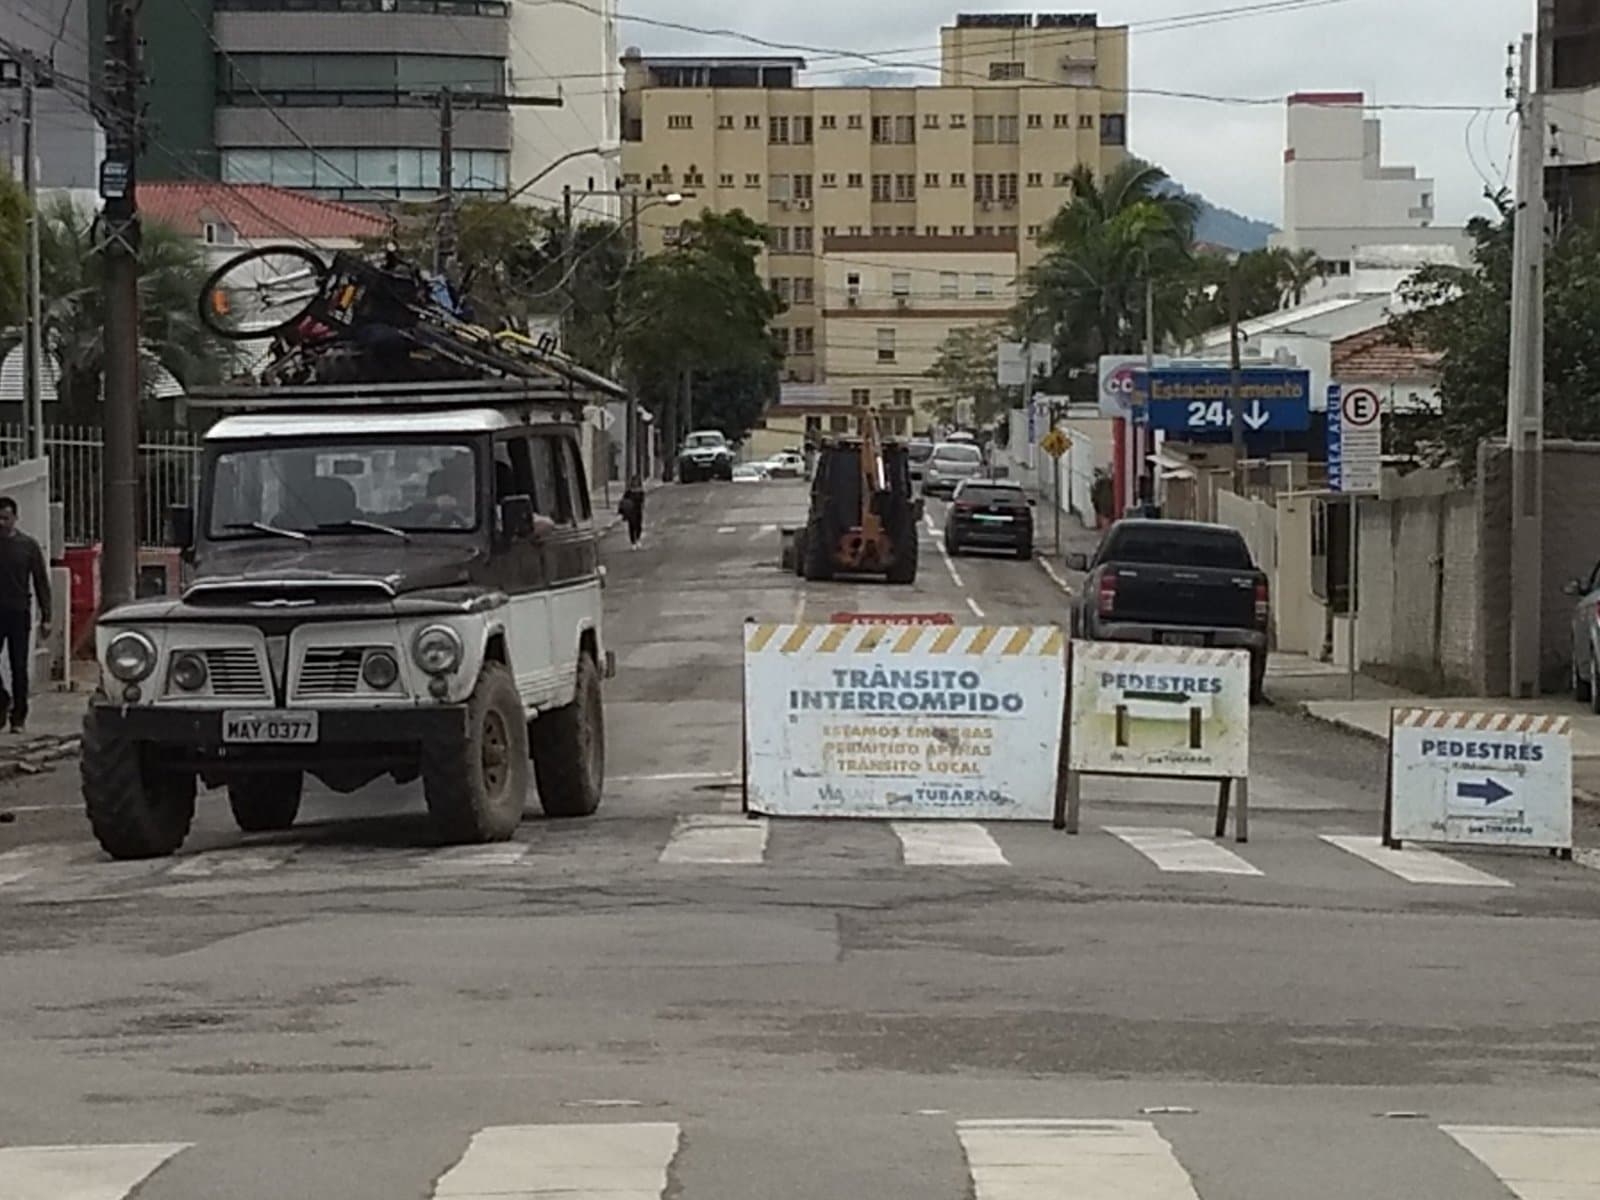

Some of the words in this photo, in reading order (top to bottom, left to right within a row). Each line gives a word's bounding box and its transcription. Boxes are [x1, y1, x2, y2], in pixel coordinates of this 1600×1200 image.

[1328, 387, 1342, 435] AZUL
[1354, 396, 1368, 418] E
[832, 663, 981, 690] TRÂNSITO
[1101, 673, 1223, 694] PEDESTRES
[790, 690, 1024, 713] INTERROMPIDO
[268, 721, 312, 739] 0377
[1421, 739, 1544, 762] PEDESTRES
[928, 761, 981, 775] LOCAL
